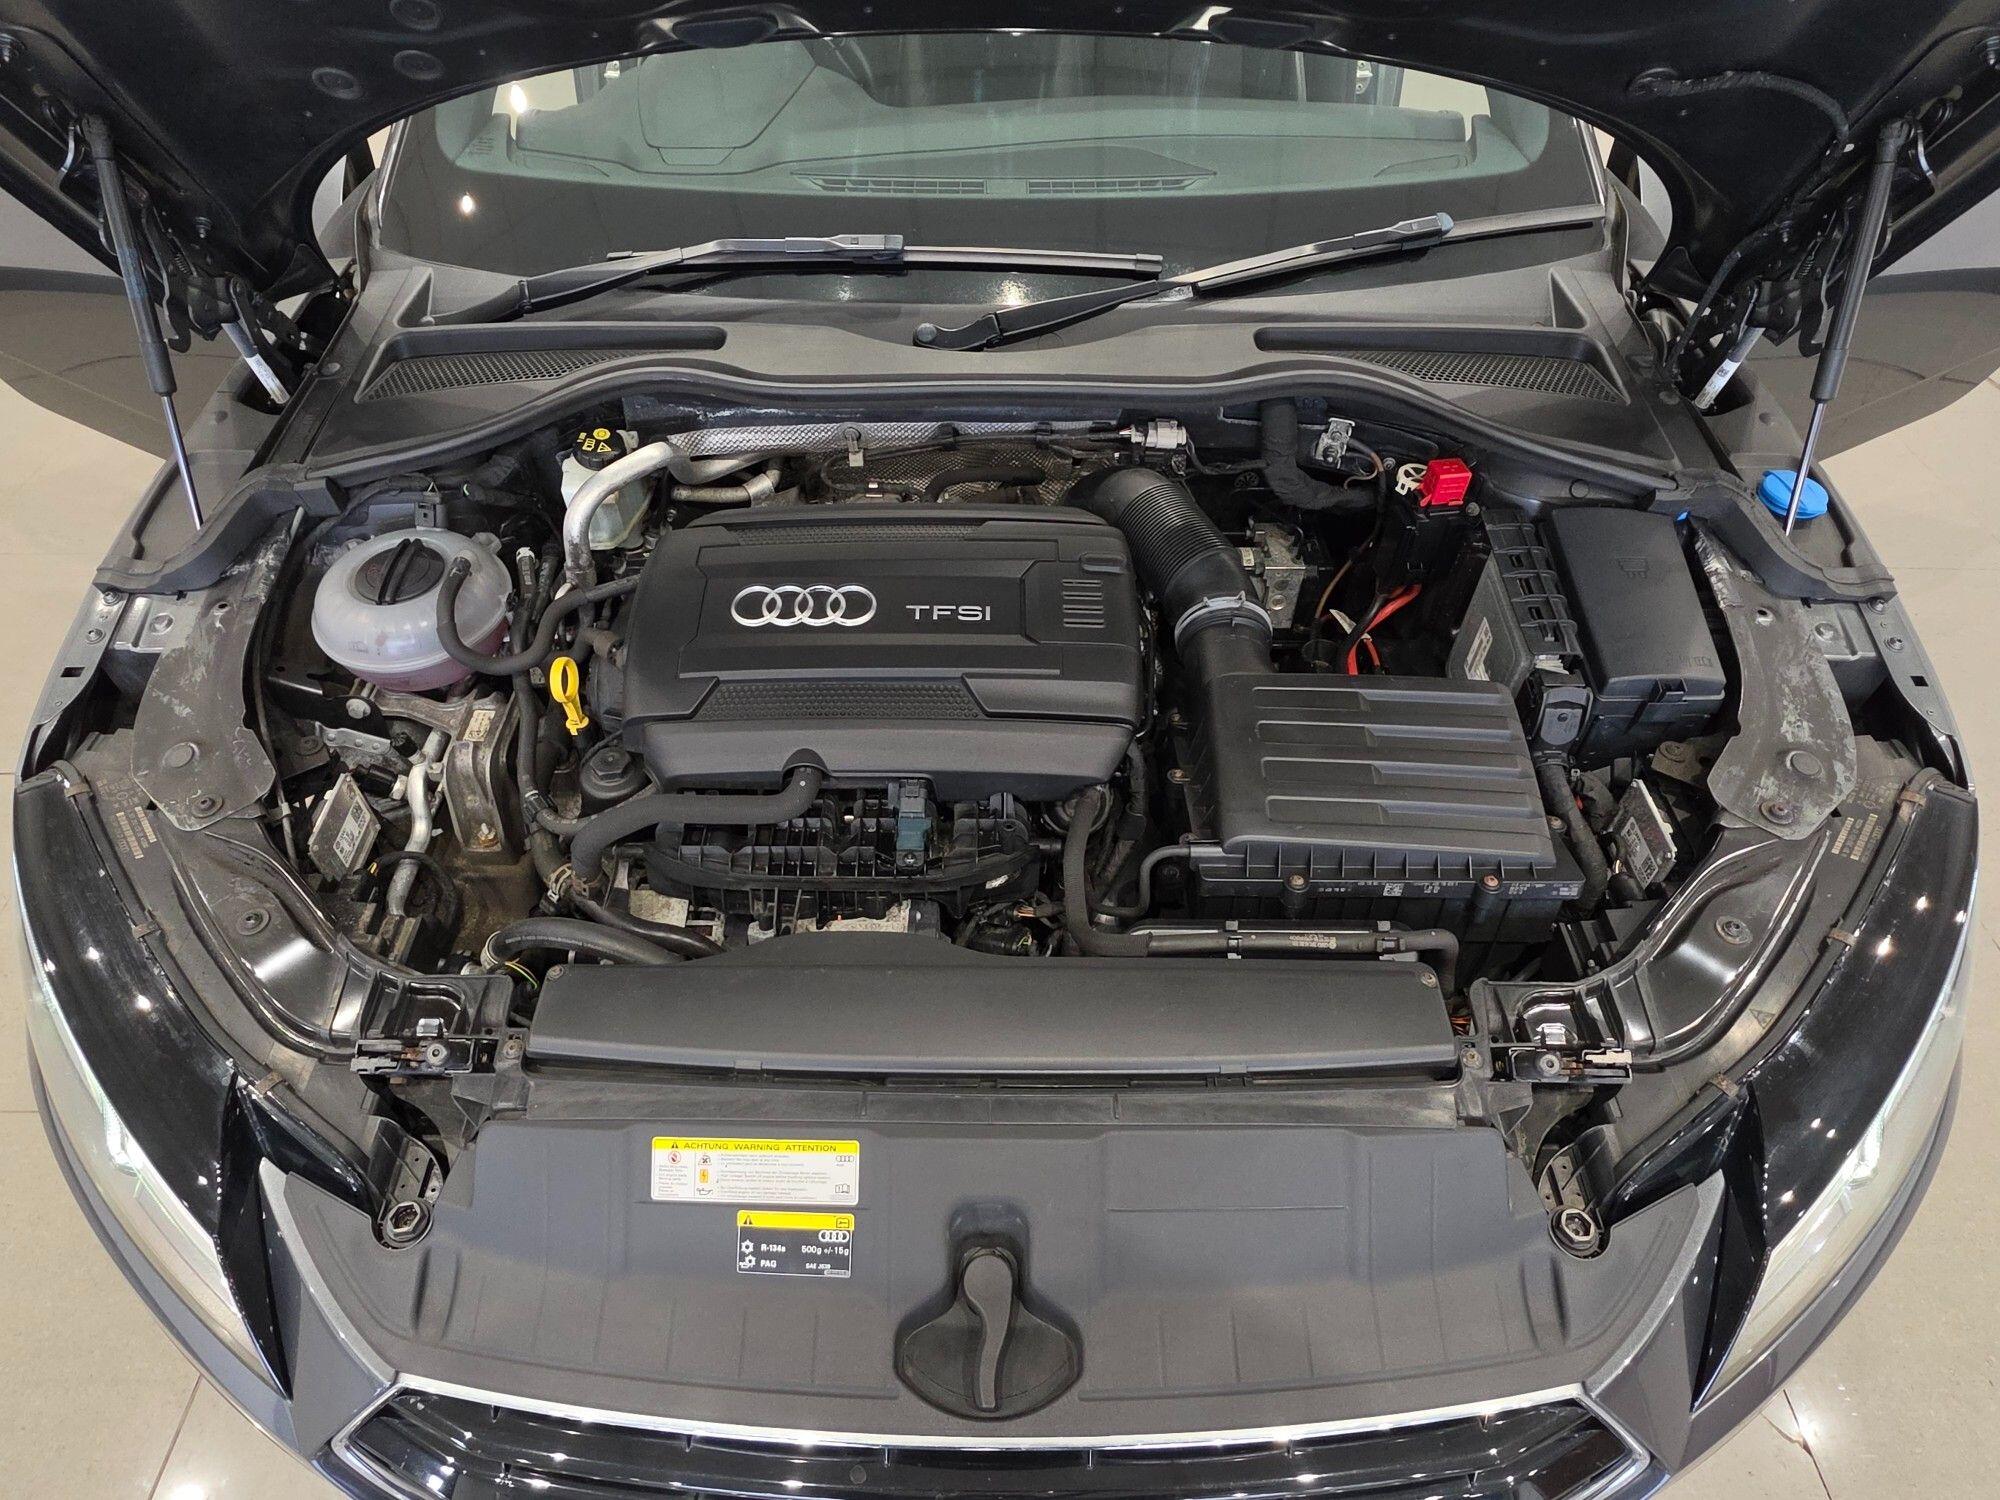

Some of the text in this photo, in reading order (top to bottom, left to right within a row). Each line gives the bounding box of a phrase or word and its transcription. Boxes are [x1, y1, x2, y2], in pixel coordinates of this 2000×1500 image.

[905, 605, 991, 621] TFSI
[683, 1142, 837, 1152] ACHTUNG WARNING ATTENTION
[801, 1245, 822, 1255] 500g
[760, 1259, 777, 1268] PAG
